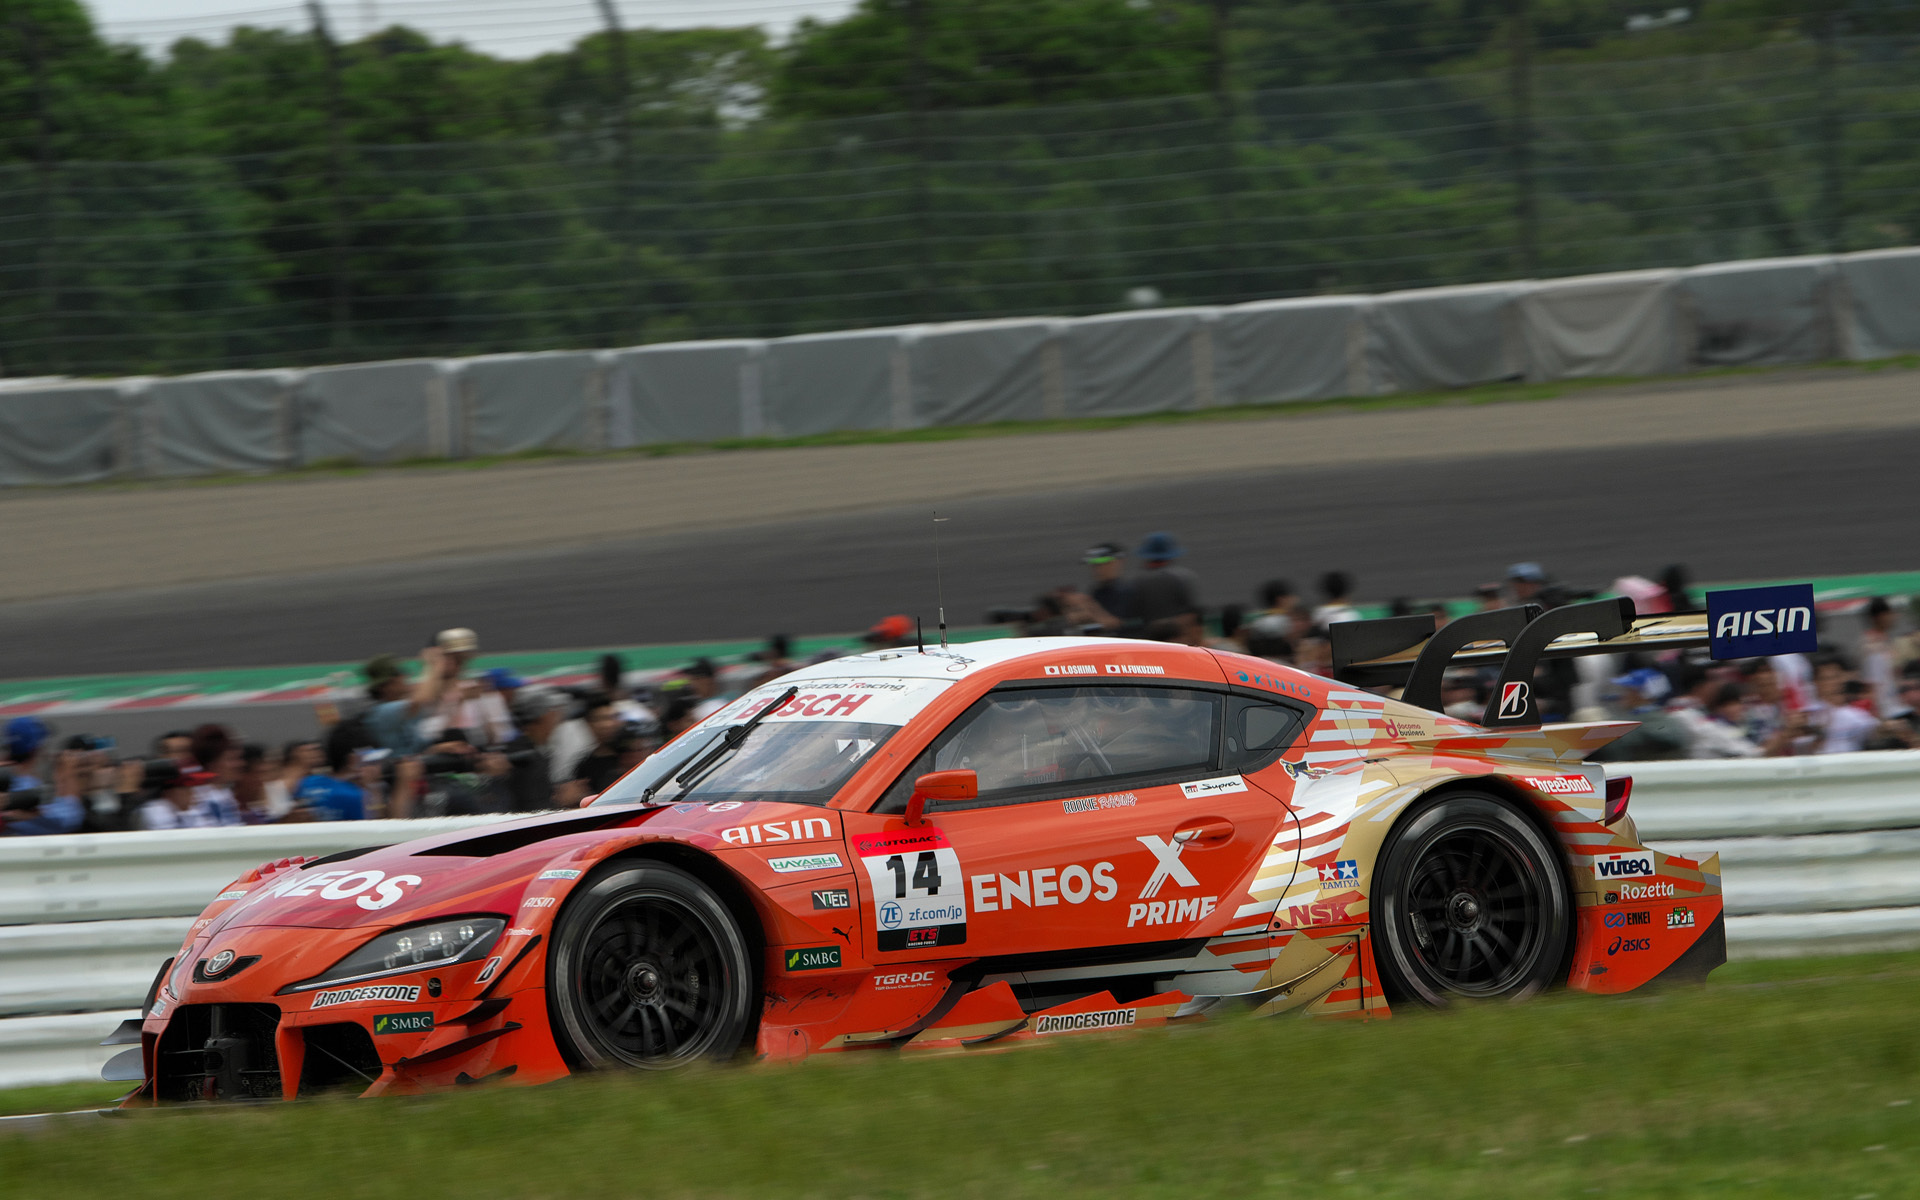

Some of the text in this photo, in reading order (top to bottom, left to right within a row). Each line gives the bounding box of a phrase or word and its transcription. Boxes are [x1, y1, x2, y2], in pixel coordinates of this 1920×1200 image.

[1716, 606, 1811, 638] AISIN
[1060, 664, 1098, 675] K.OSHIMA
[1121, 664, 1165, 675] N.FUKUZUMI
[848, 682, 905, 691] Racing
[1200, 781, 1242, 792] Supra
[1524, 776, 1593, 793] ThreeBond
[1062, 797, 1099, 814] ROOKIE
[721, 818, 832, 845] AISIN
[874, 834, 943, 848] AUTOBACS
[772, 856, 838, 869] HAYASHI
[886, 850, 942, 899] 14
[970, 861, 1119, 913] ENEOS
[1320, 879, 1360, 890] TAMIYA
[1620, 881, 1675, 900] Rozetta
[522, 896, 556, 908] AISIN
[881, 906, 901, 924] ZF
[908, 905, 963, 921] zf.com/jp
[1127, 895, 1218, 928] PRIME
[1288, 901, 1353, 927] NSK
[1627, 911, 1650, 926] ENKEI
[909, 928, 938, 942] ETS
[1622, 938, 1650, 951] asics
[802, 952, 839, 966] SMBC
[311, 985, 421, 1008] BRIDGESTONE
[391, 1016, 431, 1030] SMBC
[1036, 1008, 1136, 1034] BRIDGESTONE
